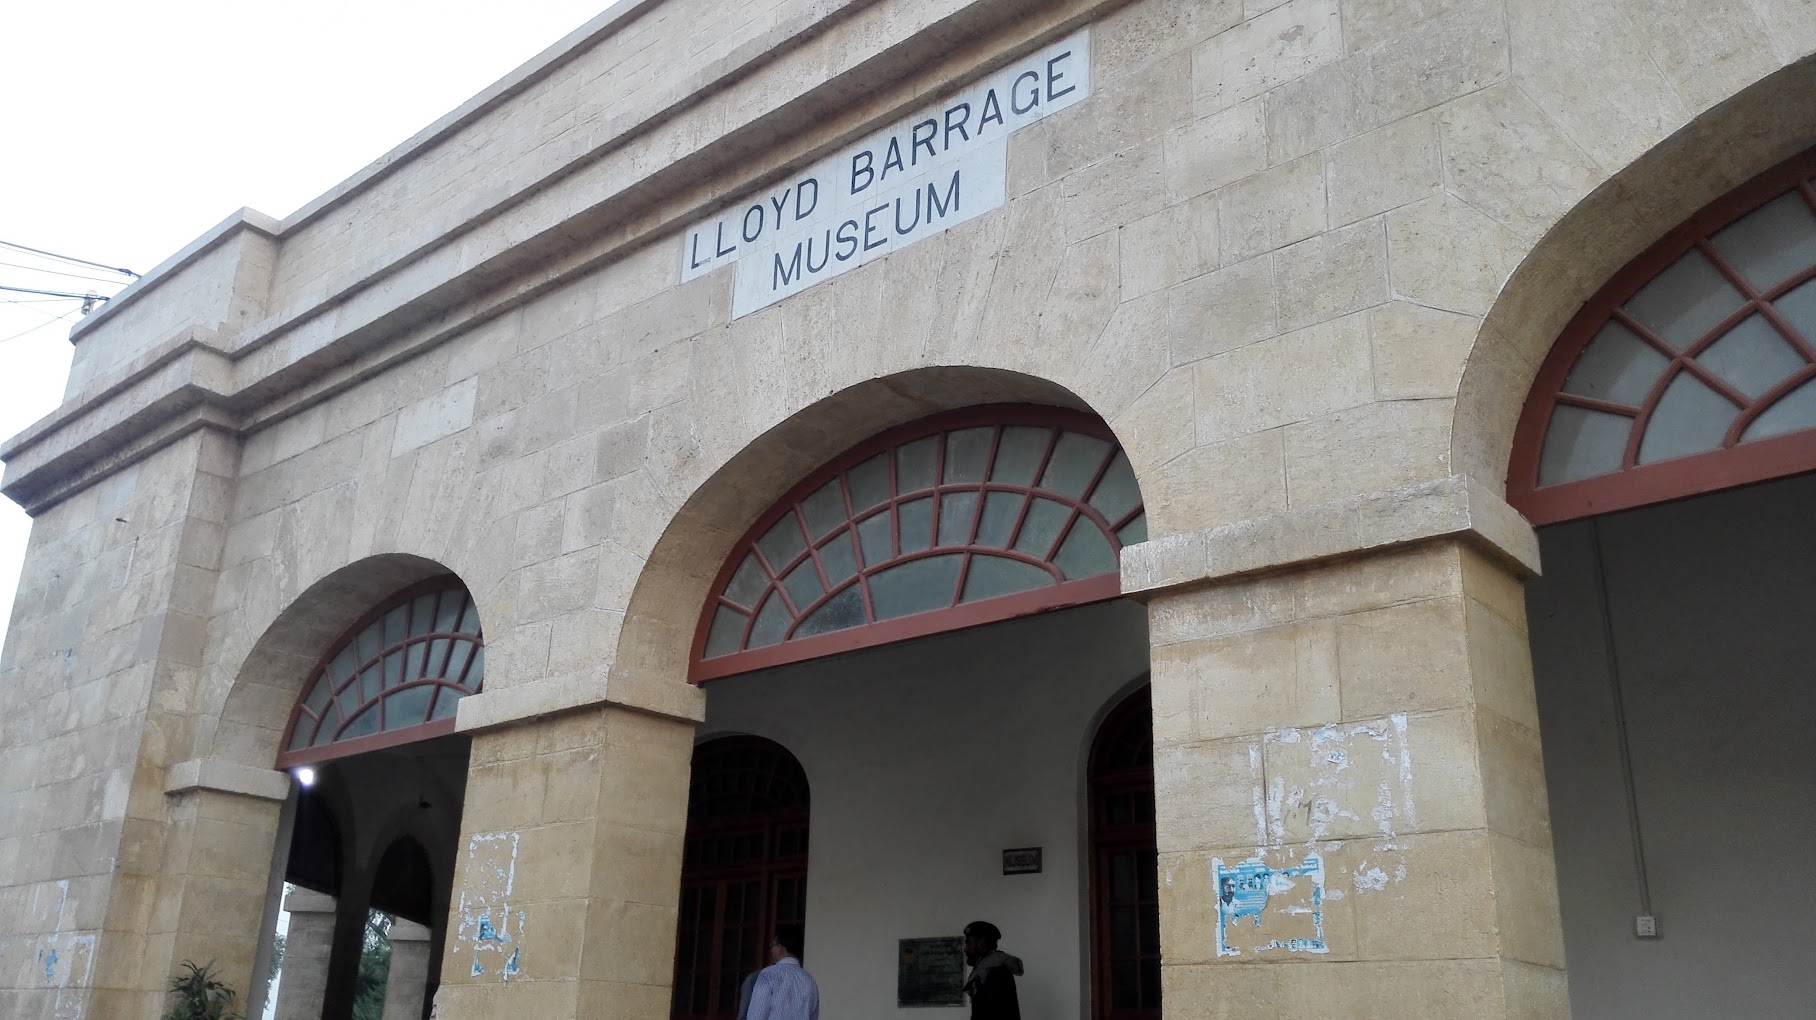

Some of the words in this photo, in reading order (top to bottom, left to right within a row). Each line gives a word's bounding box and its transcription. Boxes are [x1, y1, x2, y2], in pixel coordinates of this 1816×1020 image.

[691, 178, 818, 269] LLOYD
[851, 50, 1076, 195] BARRAGE
[772, 170, 961, 291] MUSEUM
